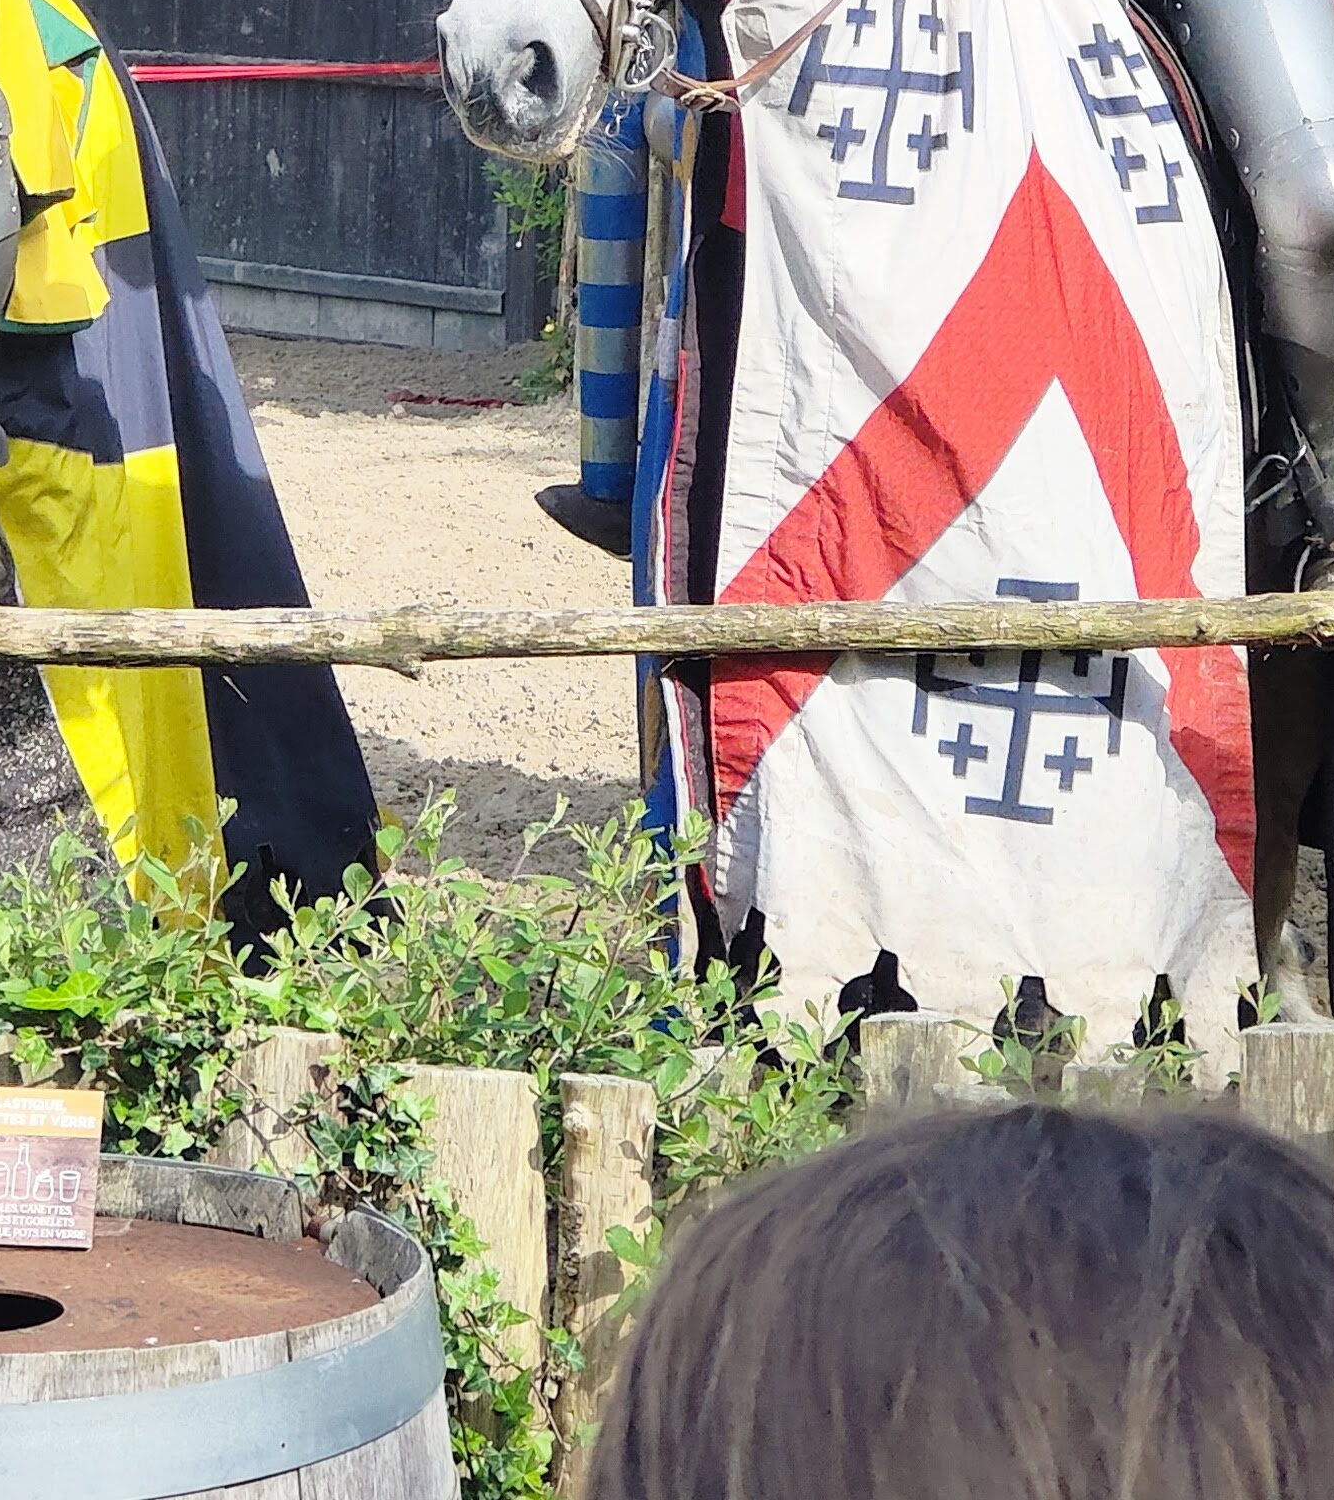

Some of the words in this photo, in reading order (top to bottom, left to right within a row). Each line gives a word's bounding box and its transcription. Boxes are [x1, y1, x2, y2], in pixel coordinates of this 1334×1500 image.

[29, 1114, 46, 1126] ET
[51, 1116, 95, 1128] VERRE
[12, 1216, 23, 1225] ET
[24, 1216, 75, 1227] GOBELETS
[13, 1228, 38, 1238] POTS
[40, 1229, 54, 1238] EN
[55, 1229, 87, 1239] VERRE
